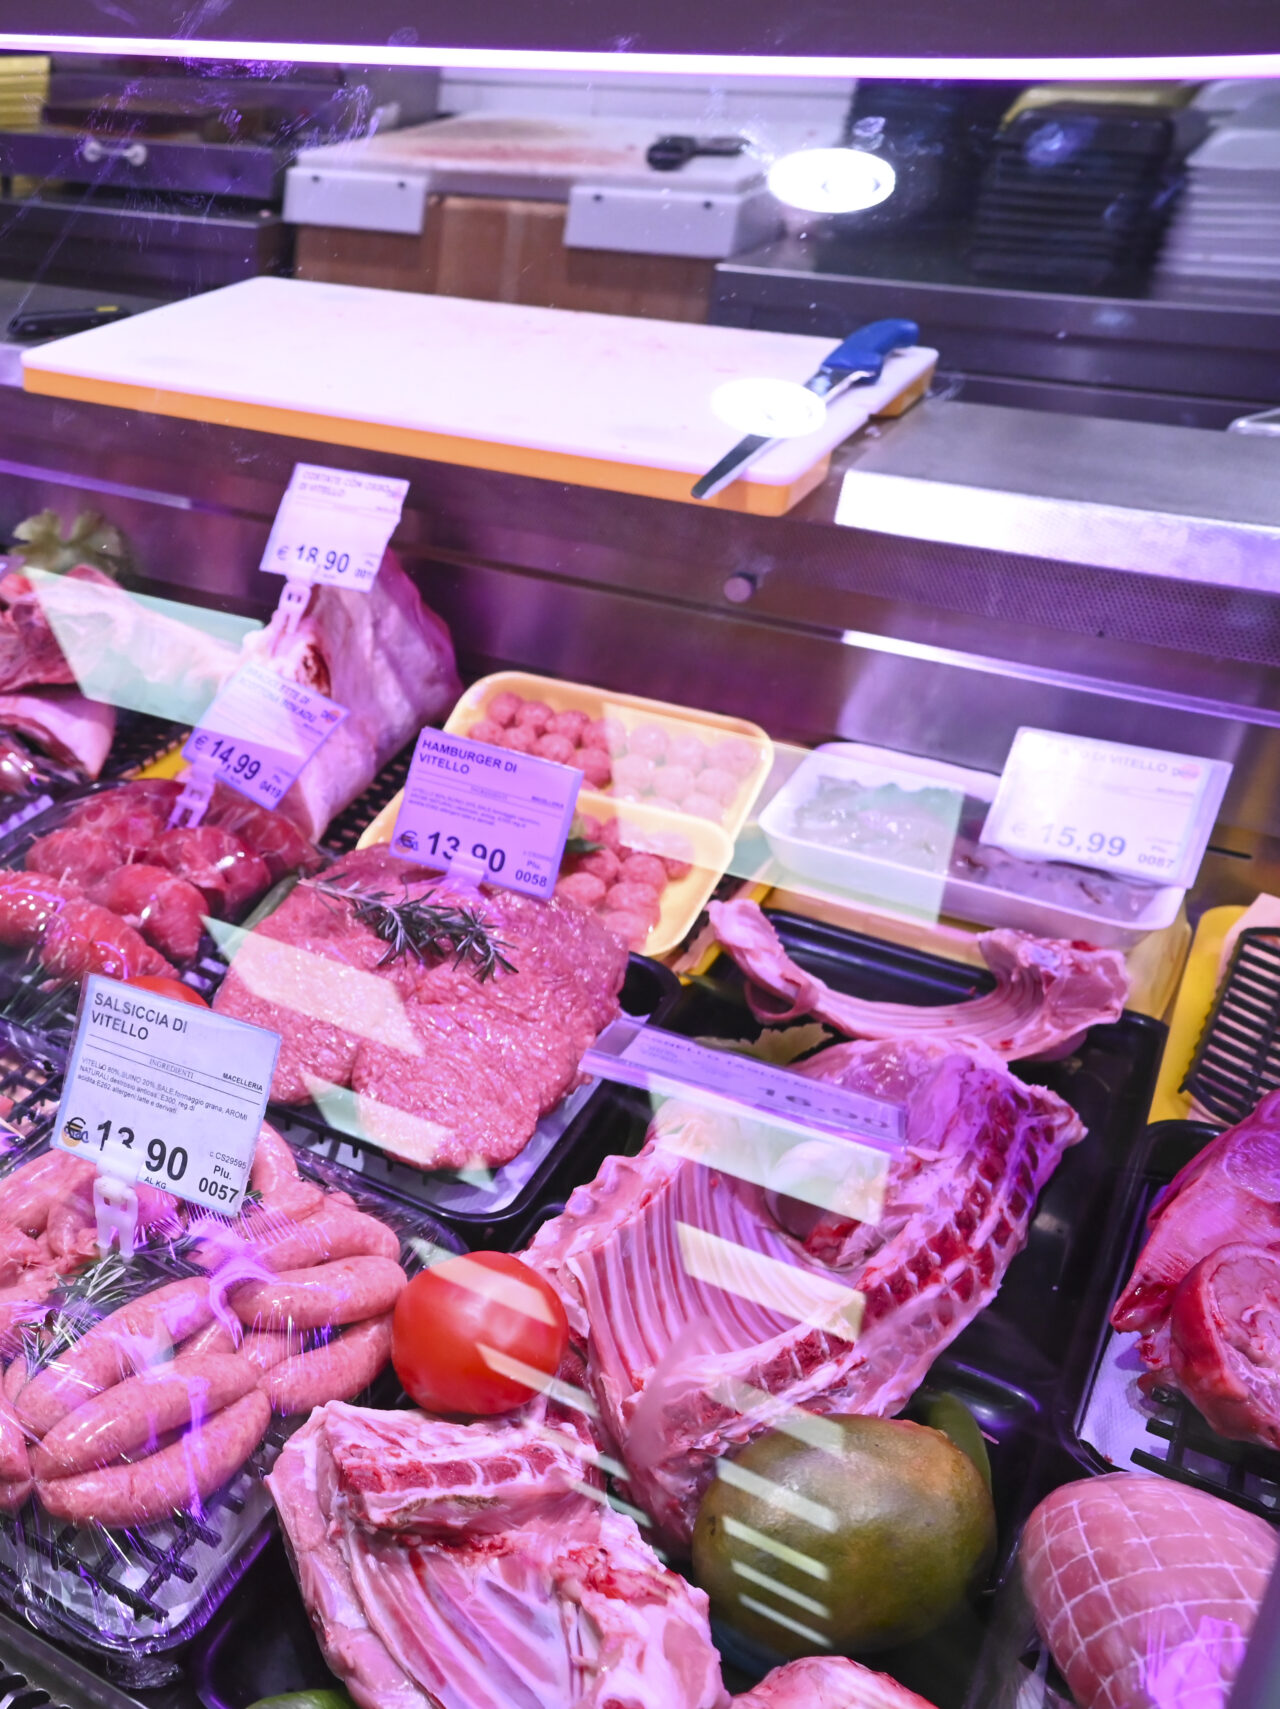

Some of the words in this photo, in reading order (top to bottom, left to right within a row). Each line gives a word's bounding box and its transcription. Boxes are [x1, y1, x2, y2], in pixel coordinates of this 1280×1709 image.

[194, 734, 209, 751] €
[211, 739, 261, 780] 14,99
[419, 752, 470, 774] VITELLO
[422, 740, 501, 768] HAMBURGER
[503, 761, 517, 772] DI
[1111, 756, 1168, 773] VITELLO
[428, 831, 505, 872] 1390
[514, 869, 547, 887] 0058
[94, 992, 168, 1027] SALSICCIA
[171, 1017, 187, 1033] DI
[91, 1010, 148, 1040] VITELLO
[148, 1058, 193, 1079] INGREDIENTI
[222, 1072, 262, 1091] MACELLERIA
[224, 1107, 247, 1120] AROMI
[63, 1116, 86, 1141] €
[97, 1120, 188, 1180] 1390
[144, 1175, 153, 1185] AL
[155, 1180, 166, 1189] KG
[212, 1164, 231, 1180] Plu.
[198, 1177, 239, 1203] 0057
